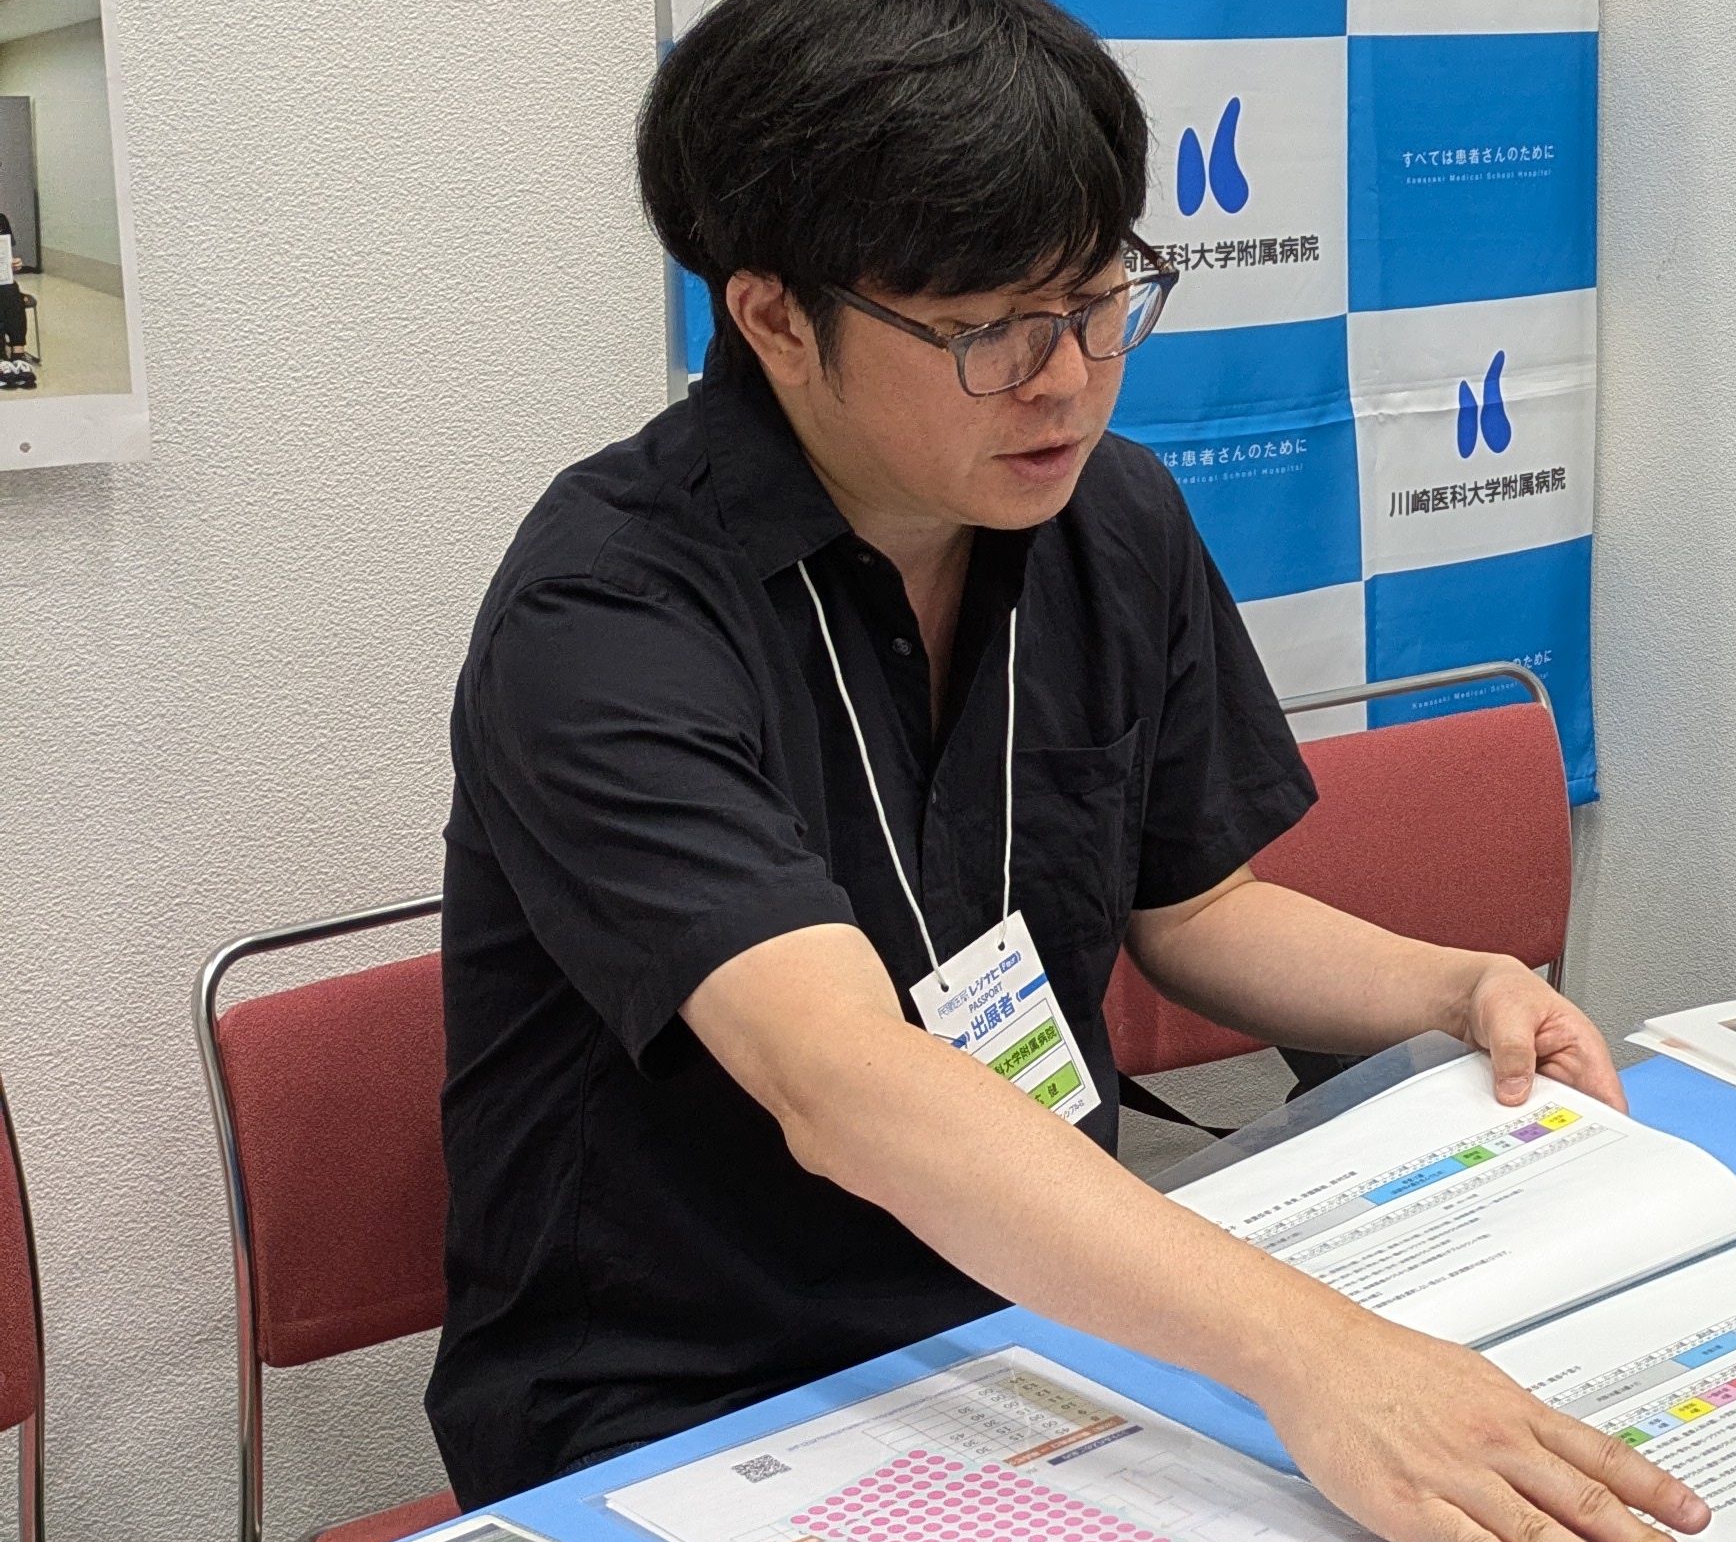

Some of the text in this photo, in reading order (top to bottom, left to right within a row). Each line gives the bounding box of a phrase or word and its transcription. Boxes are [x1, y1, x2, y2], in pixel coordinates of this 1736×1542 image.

[1402, 144, 1554, 167] すべては患者さんのために
[1389, 465, 1567, 518] 川崎医科大学附属病院
[968, 981, 1004, 1013] PASSPORT
[970, 992, 1016, 1041] 出展者
